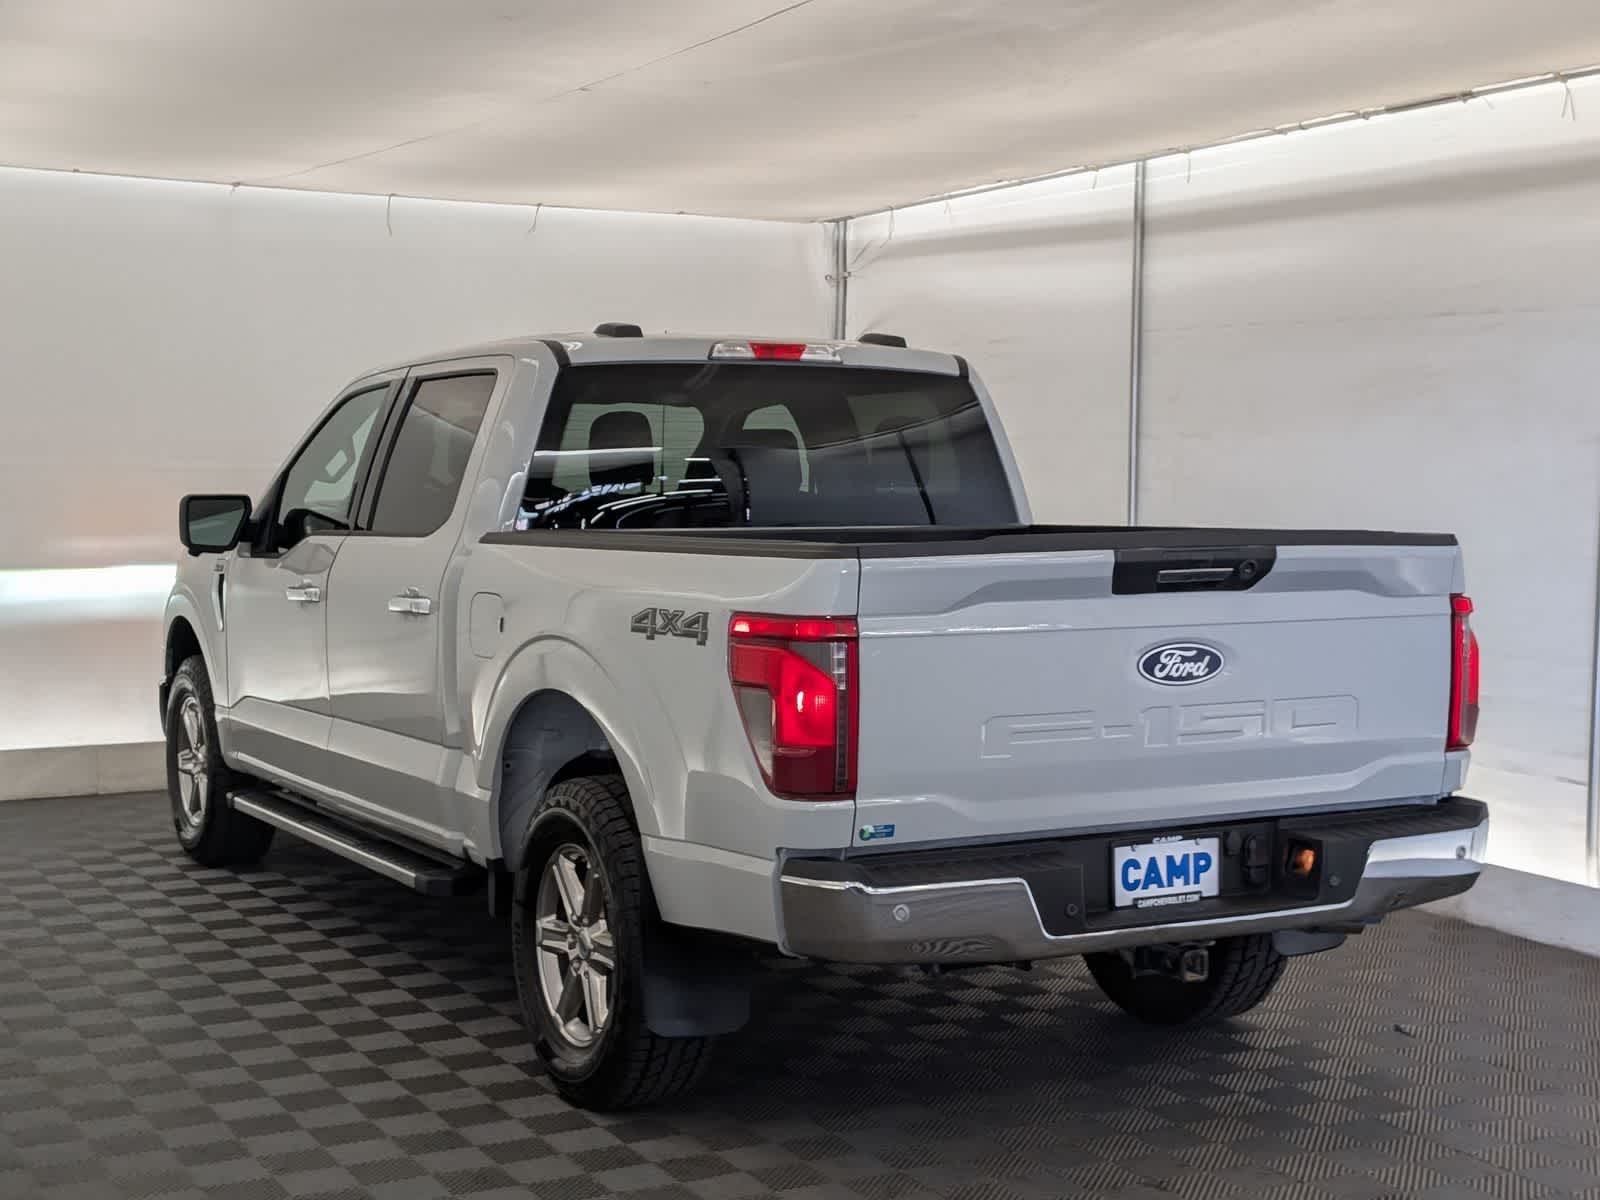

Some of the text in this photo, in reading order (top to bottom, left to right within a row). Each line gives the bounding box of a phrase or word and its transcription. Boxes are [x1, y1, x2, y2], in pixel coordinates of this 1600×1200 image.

[1154, 649, 1211, 678] Ford
[980, 695, 1359, 759] F-150
[1121, 852, 1212, 892] CAMP
